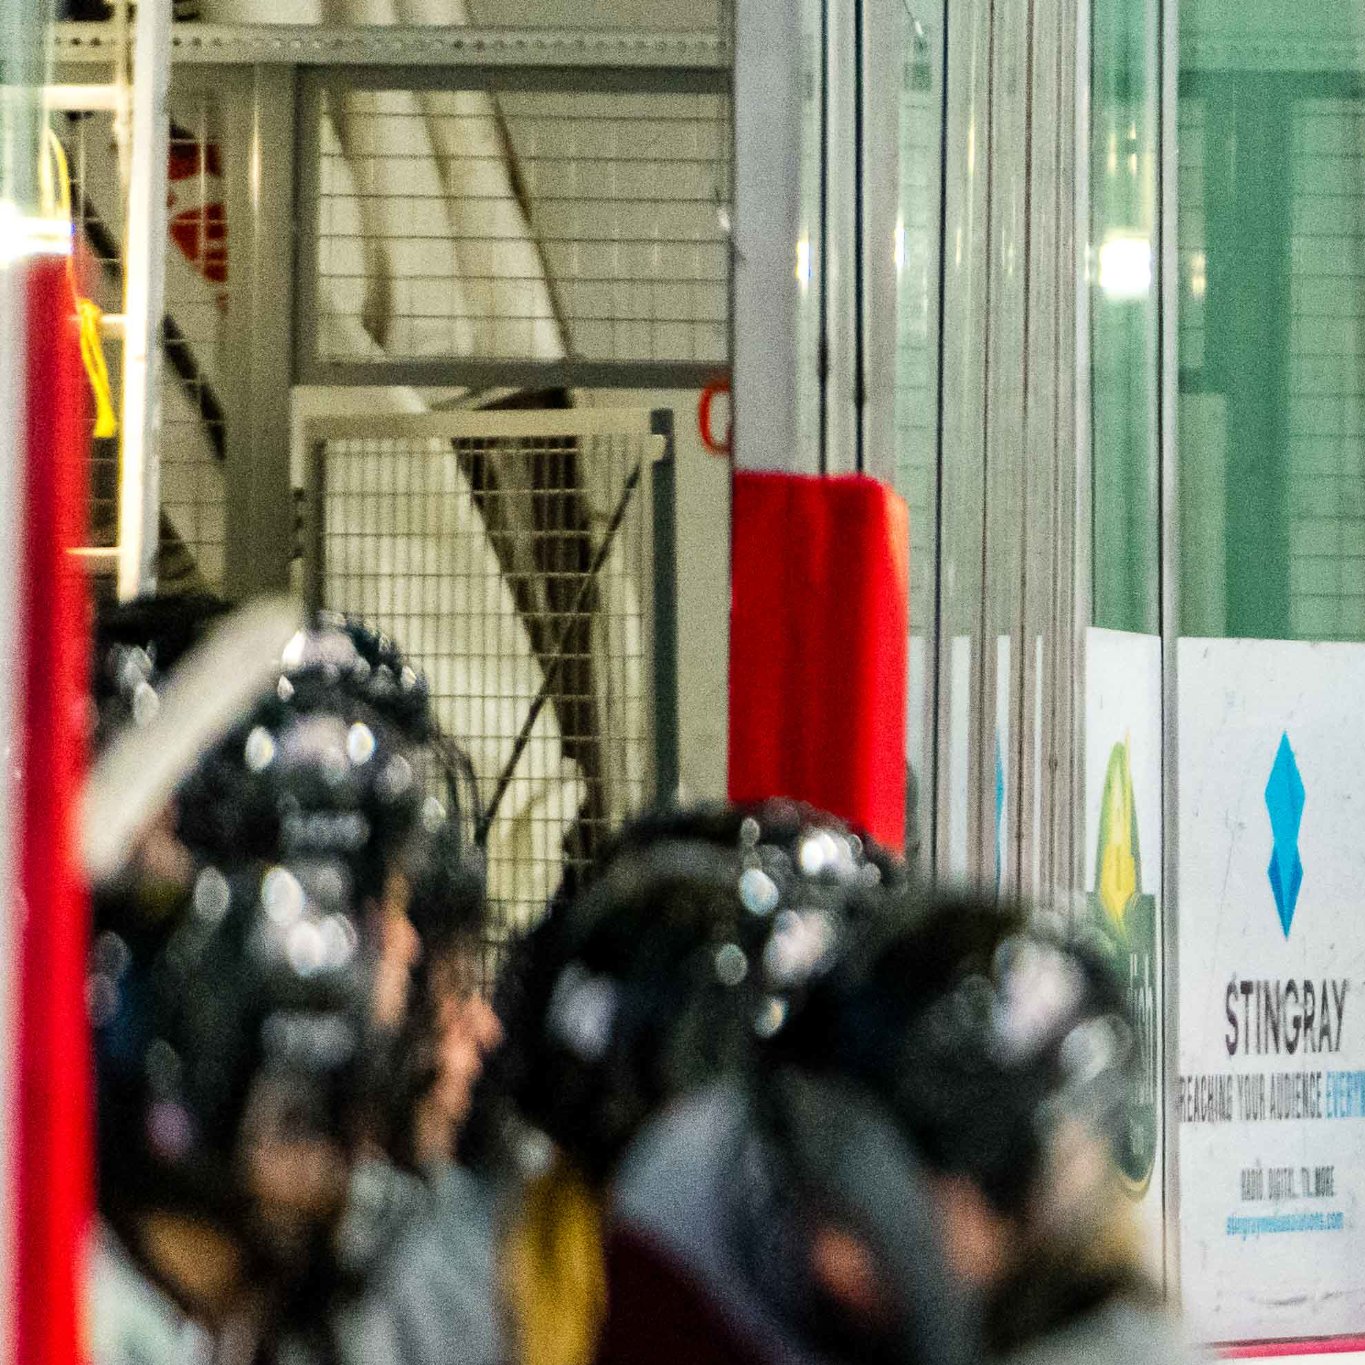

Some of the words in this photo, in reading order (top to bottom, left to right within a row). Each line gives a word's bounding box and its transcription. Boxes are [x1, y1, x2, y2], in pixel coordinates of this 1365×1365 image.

[1225, 977, 1350, 1056] STINGRAY
[1180, 1073, 1233, 1123] REACHING
[1237, 1072, 1266, 1121] YOUR
[1269, 1071, 1322, 1120] AUDIENCE
